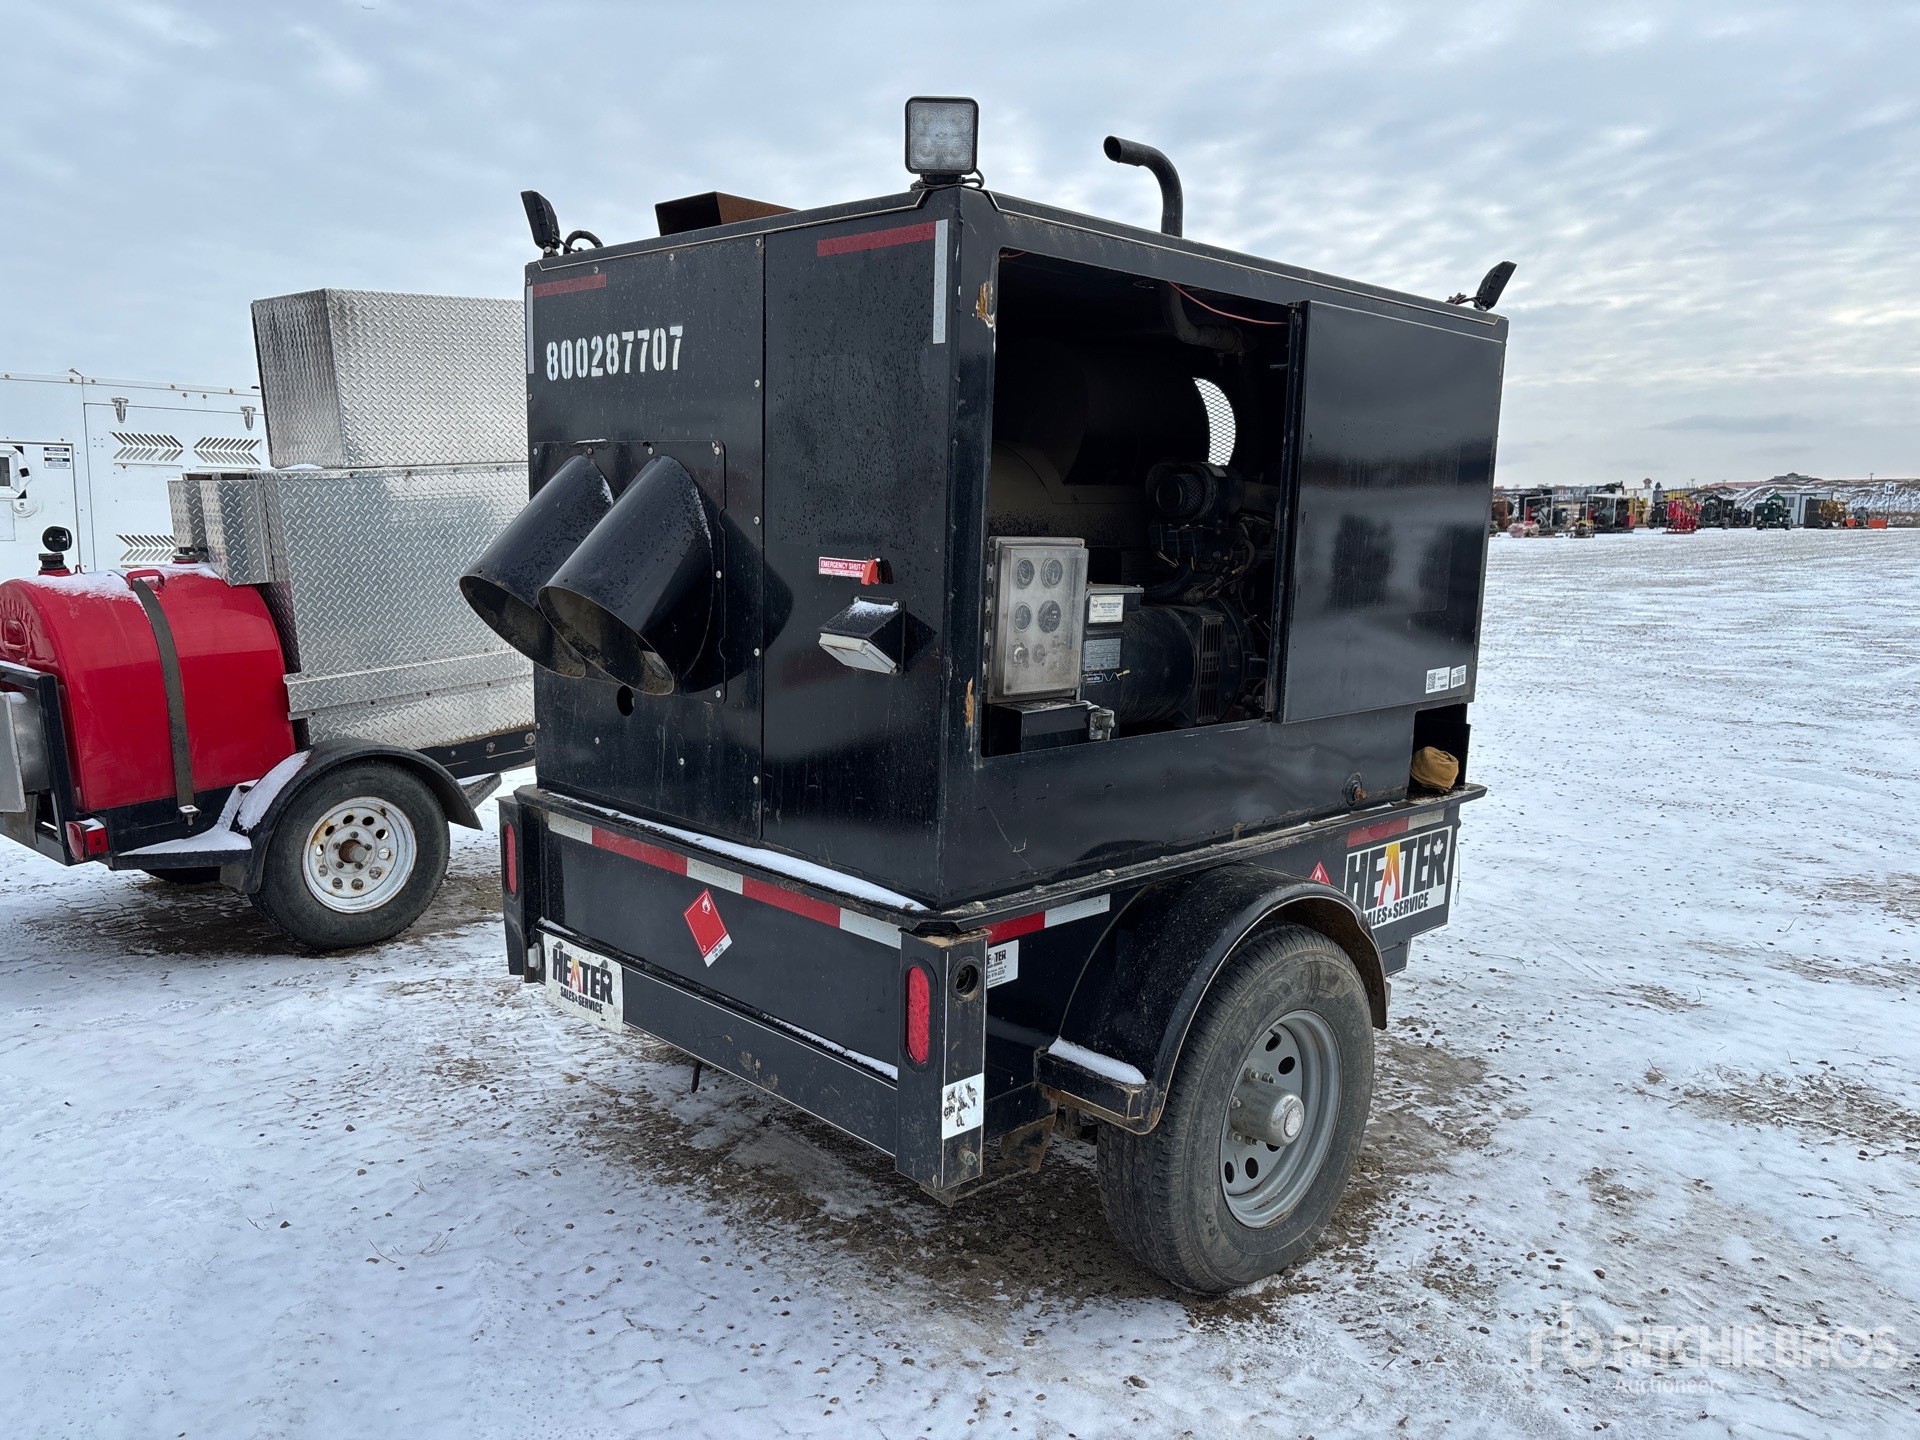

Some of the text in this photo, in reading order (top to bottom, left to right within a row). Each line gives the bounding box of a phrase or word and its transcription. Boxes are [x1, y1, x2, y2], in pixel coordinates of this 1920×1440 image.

[546, 325, 683, 381] 800287707
[1885, 485, 1895, 493] 14
[820, 560, 848, 570] EMERGENCY
[1344, 829, 1448, 912] HEATER
[553, 948, 613, 1005] HEATER
